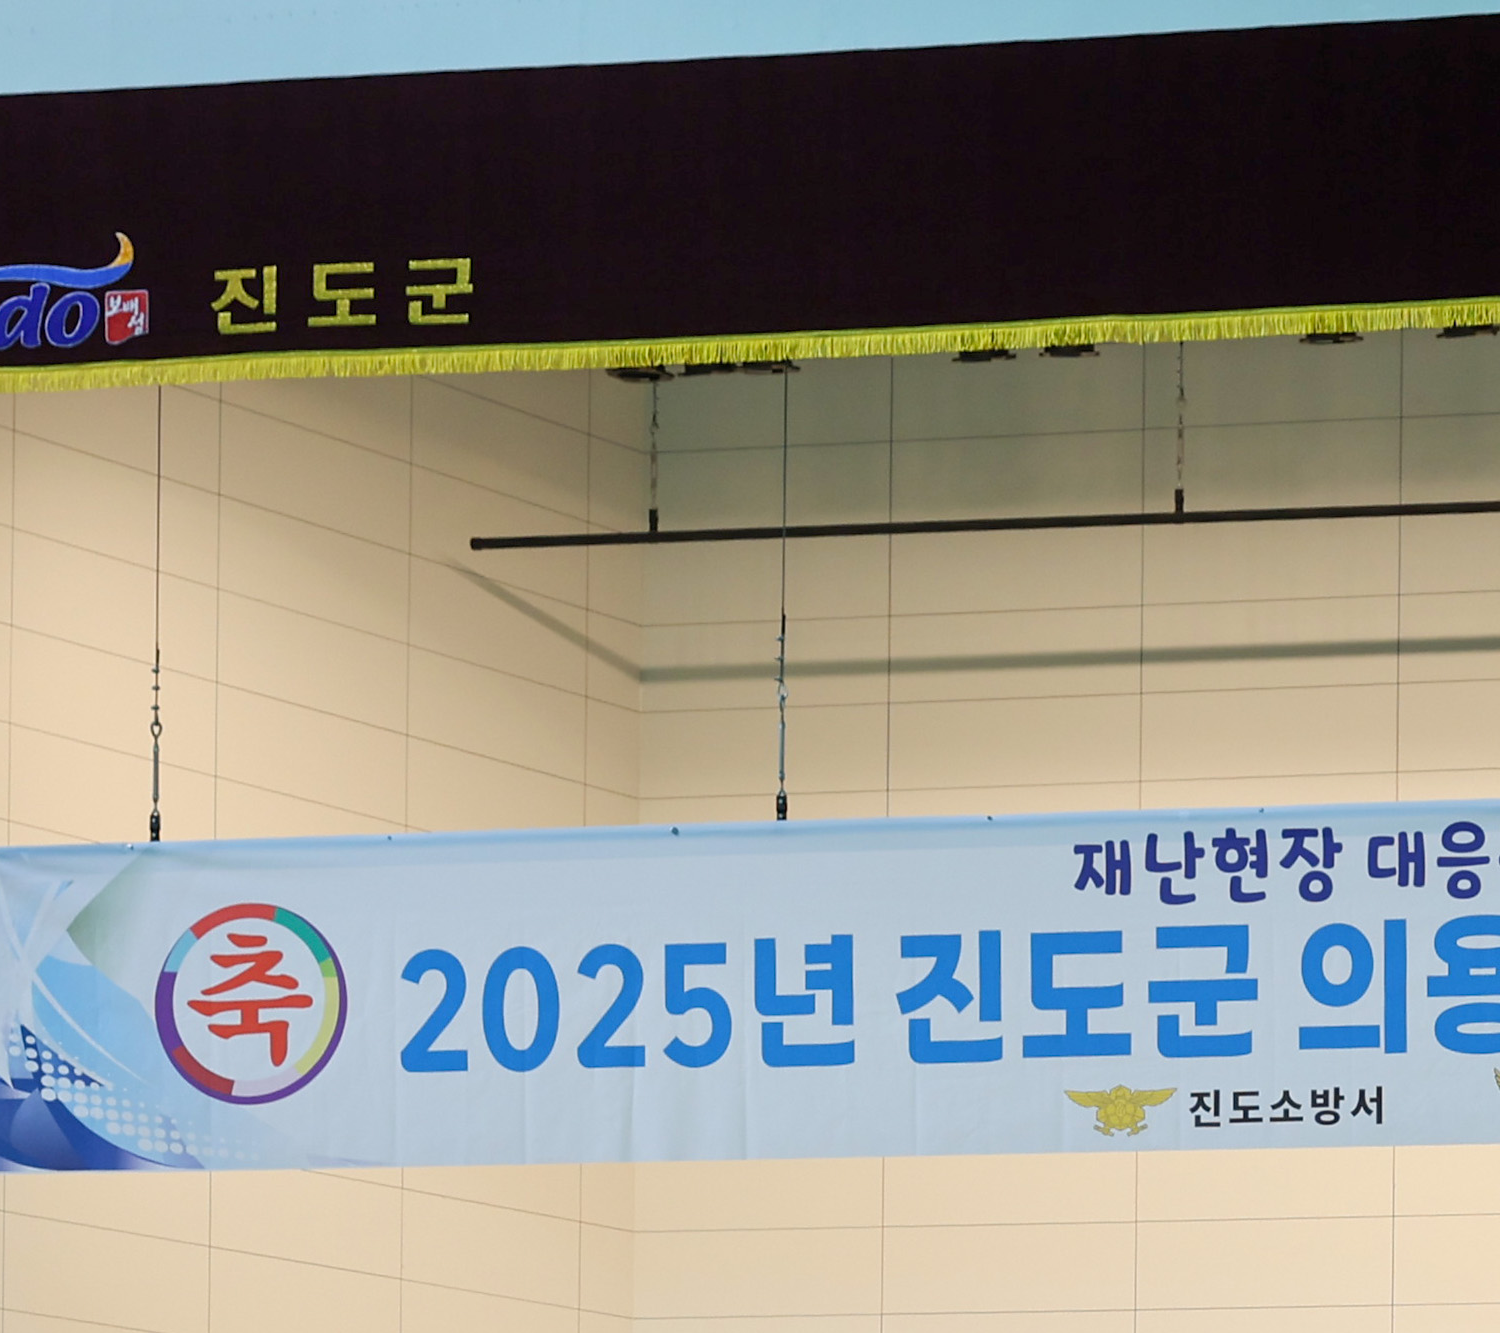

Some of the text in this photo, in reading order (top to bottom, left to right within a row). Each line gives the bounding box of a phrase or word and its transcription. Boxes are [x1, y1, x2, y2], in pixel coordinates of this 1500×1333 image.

[211, 258, 473, 333] 진도군
[1074, 827, 1342, 904] 재난현장
[185, 933, 312, 1068] 축
[401, 935, 854, 1072] 2025년
[897, 925, 1258, 1063] 진도군
[1190, 1086, 1384, 1127] 진도소방서
